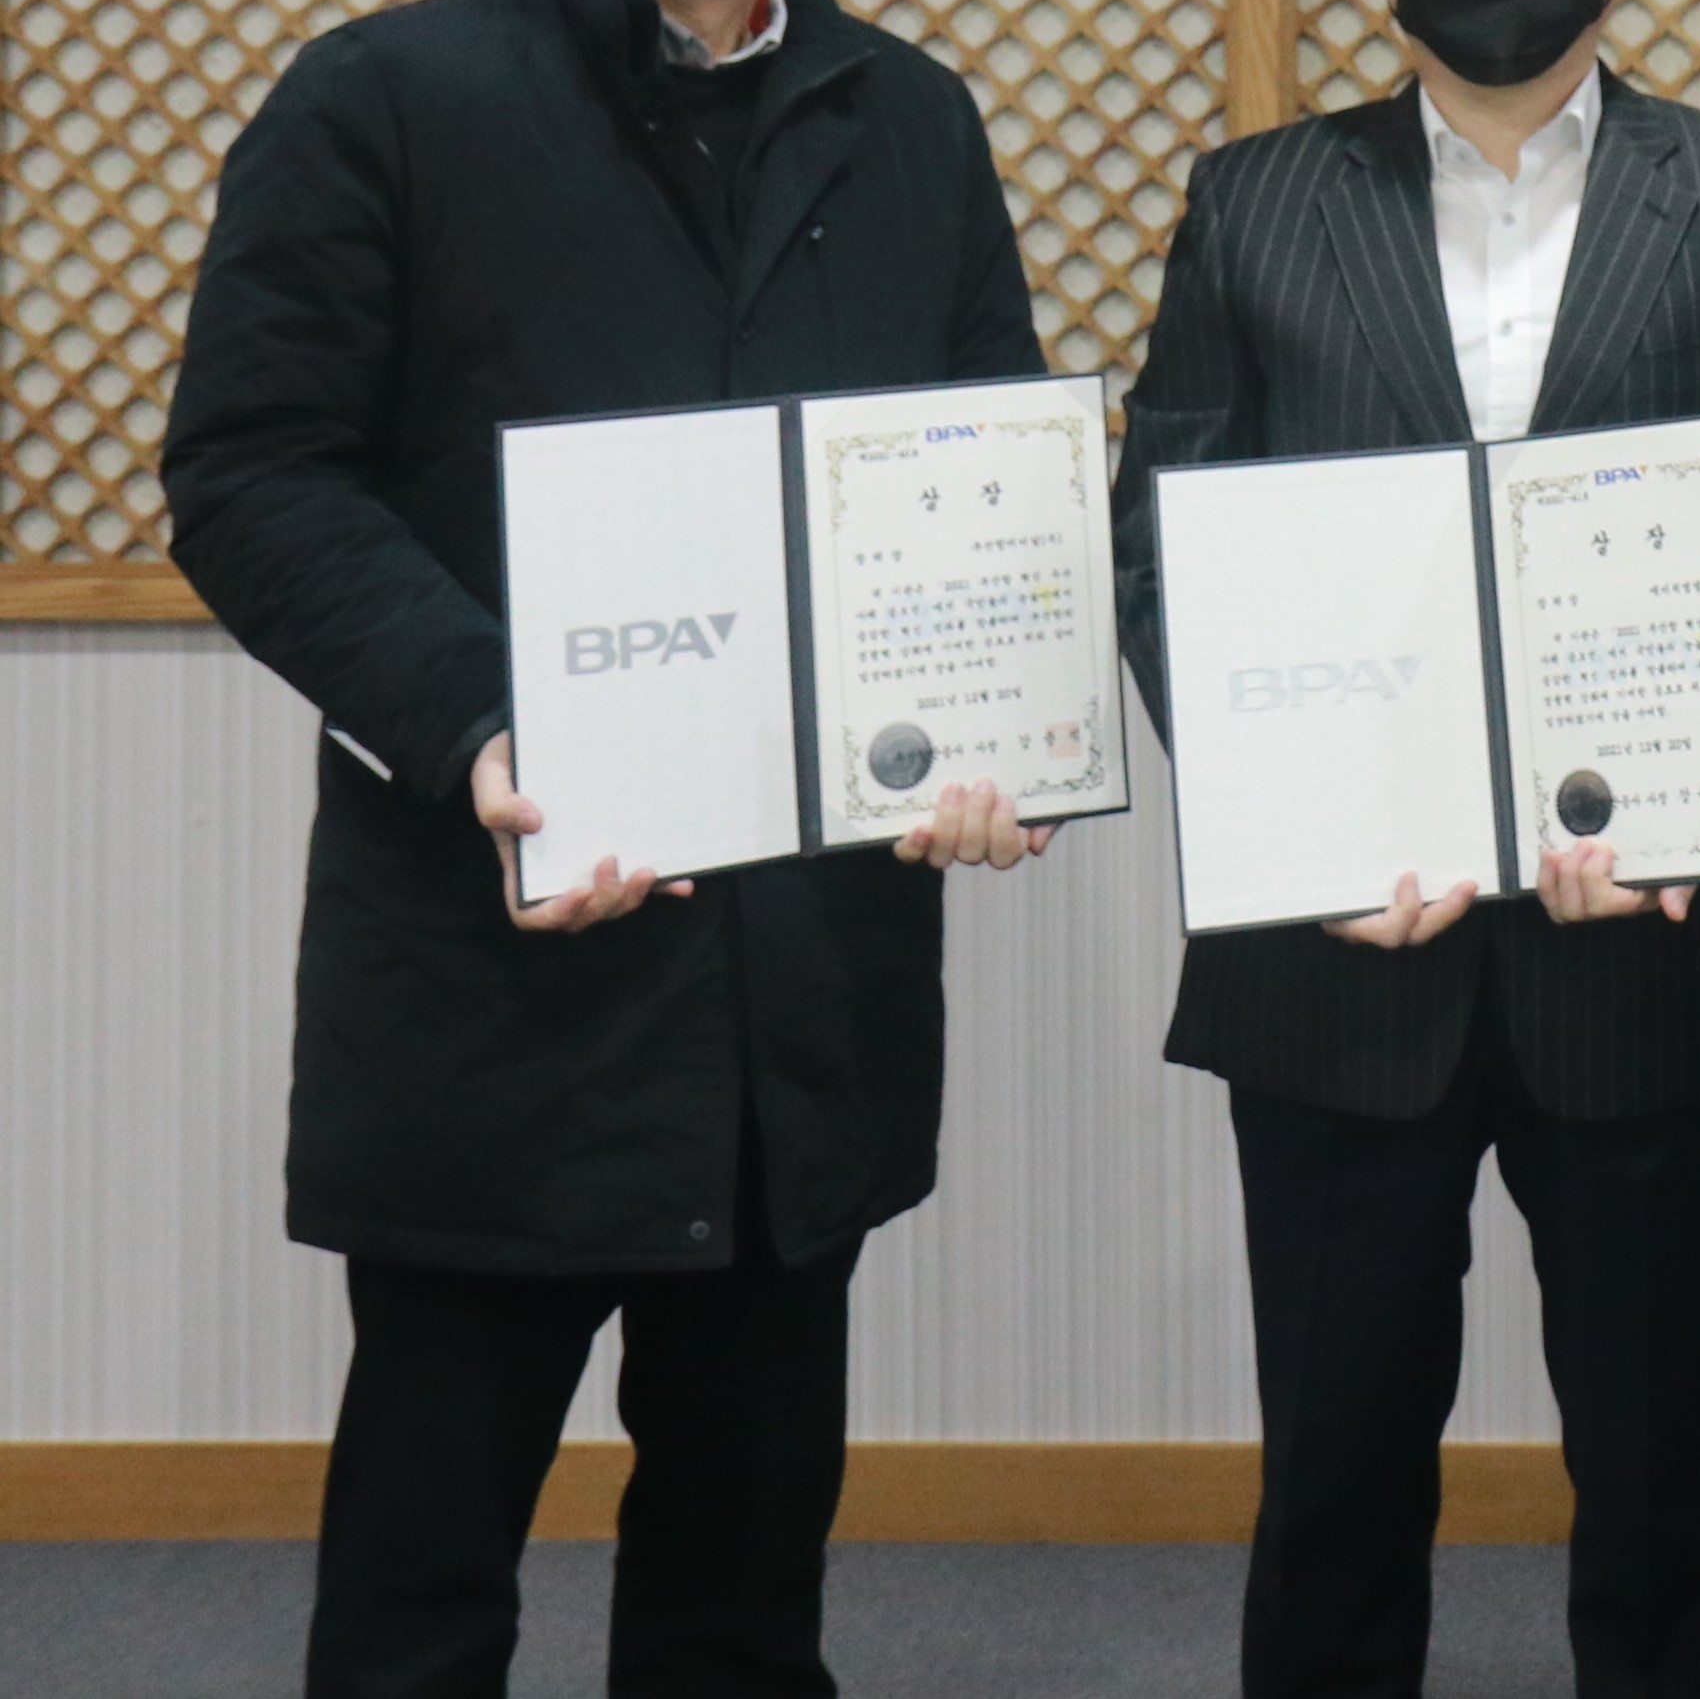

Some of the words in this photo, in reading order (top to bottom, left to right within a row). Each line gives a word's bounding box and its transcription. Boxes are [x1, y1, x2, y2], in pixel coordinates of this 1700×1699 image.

[926, 425, 977, 443] BPA
[1595, 467, 1641, 486] BPA
[920, 485, 941, 513] 상
[982, 480, 1002, 507] 장
[1591, 530, 1611, 557] 상
[1646, 523, 1666, 550] 장
[564, 617, 716, 676] BPA
[1227, 658, 1400, 714] BPA
